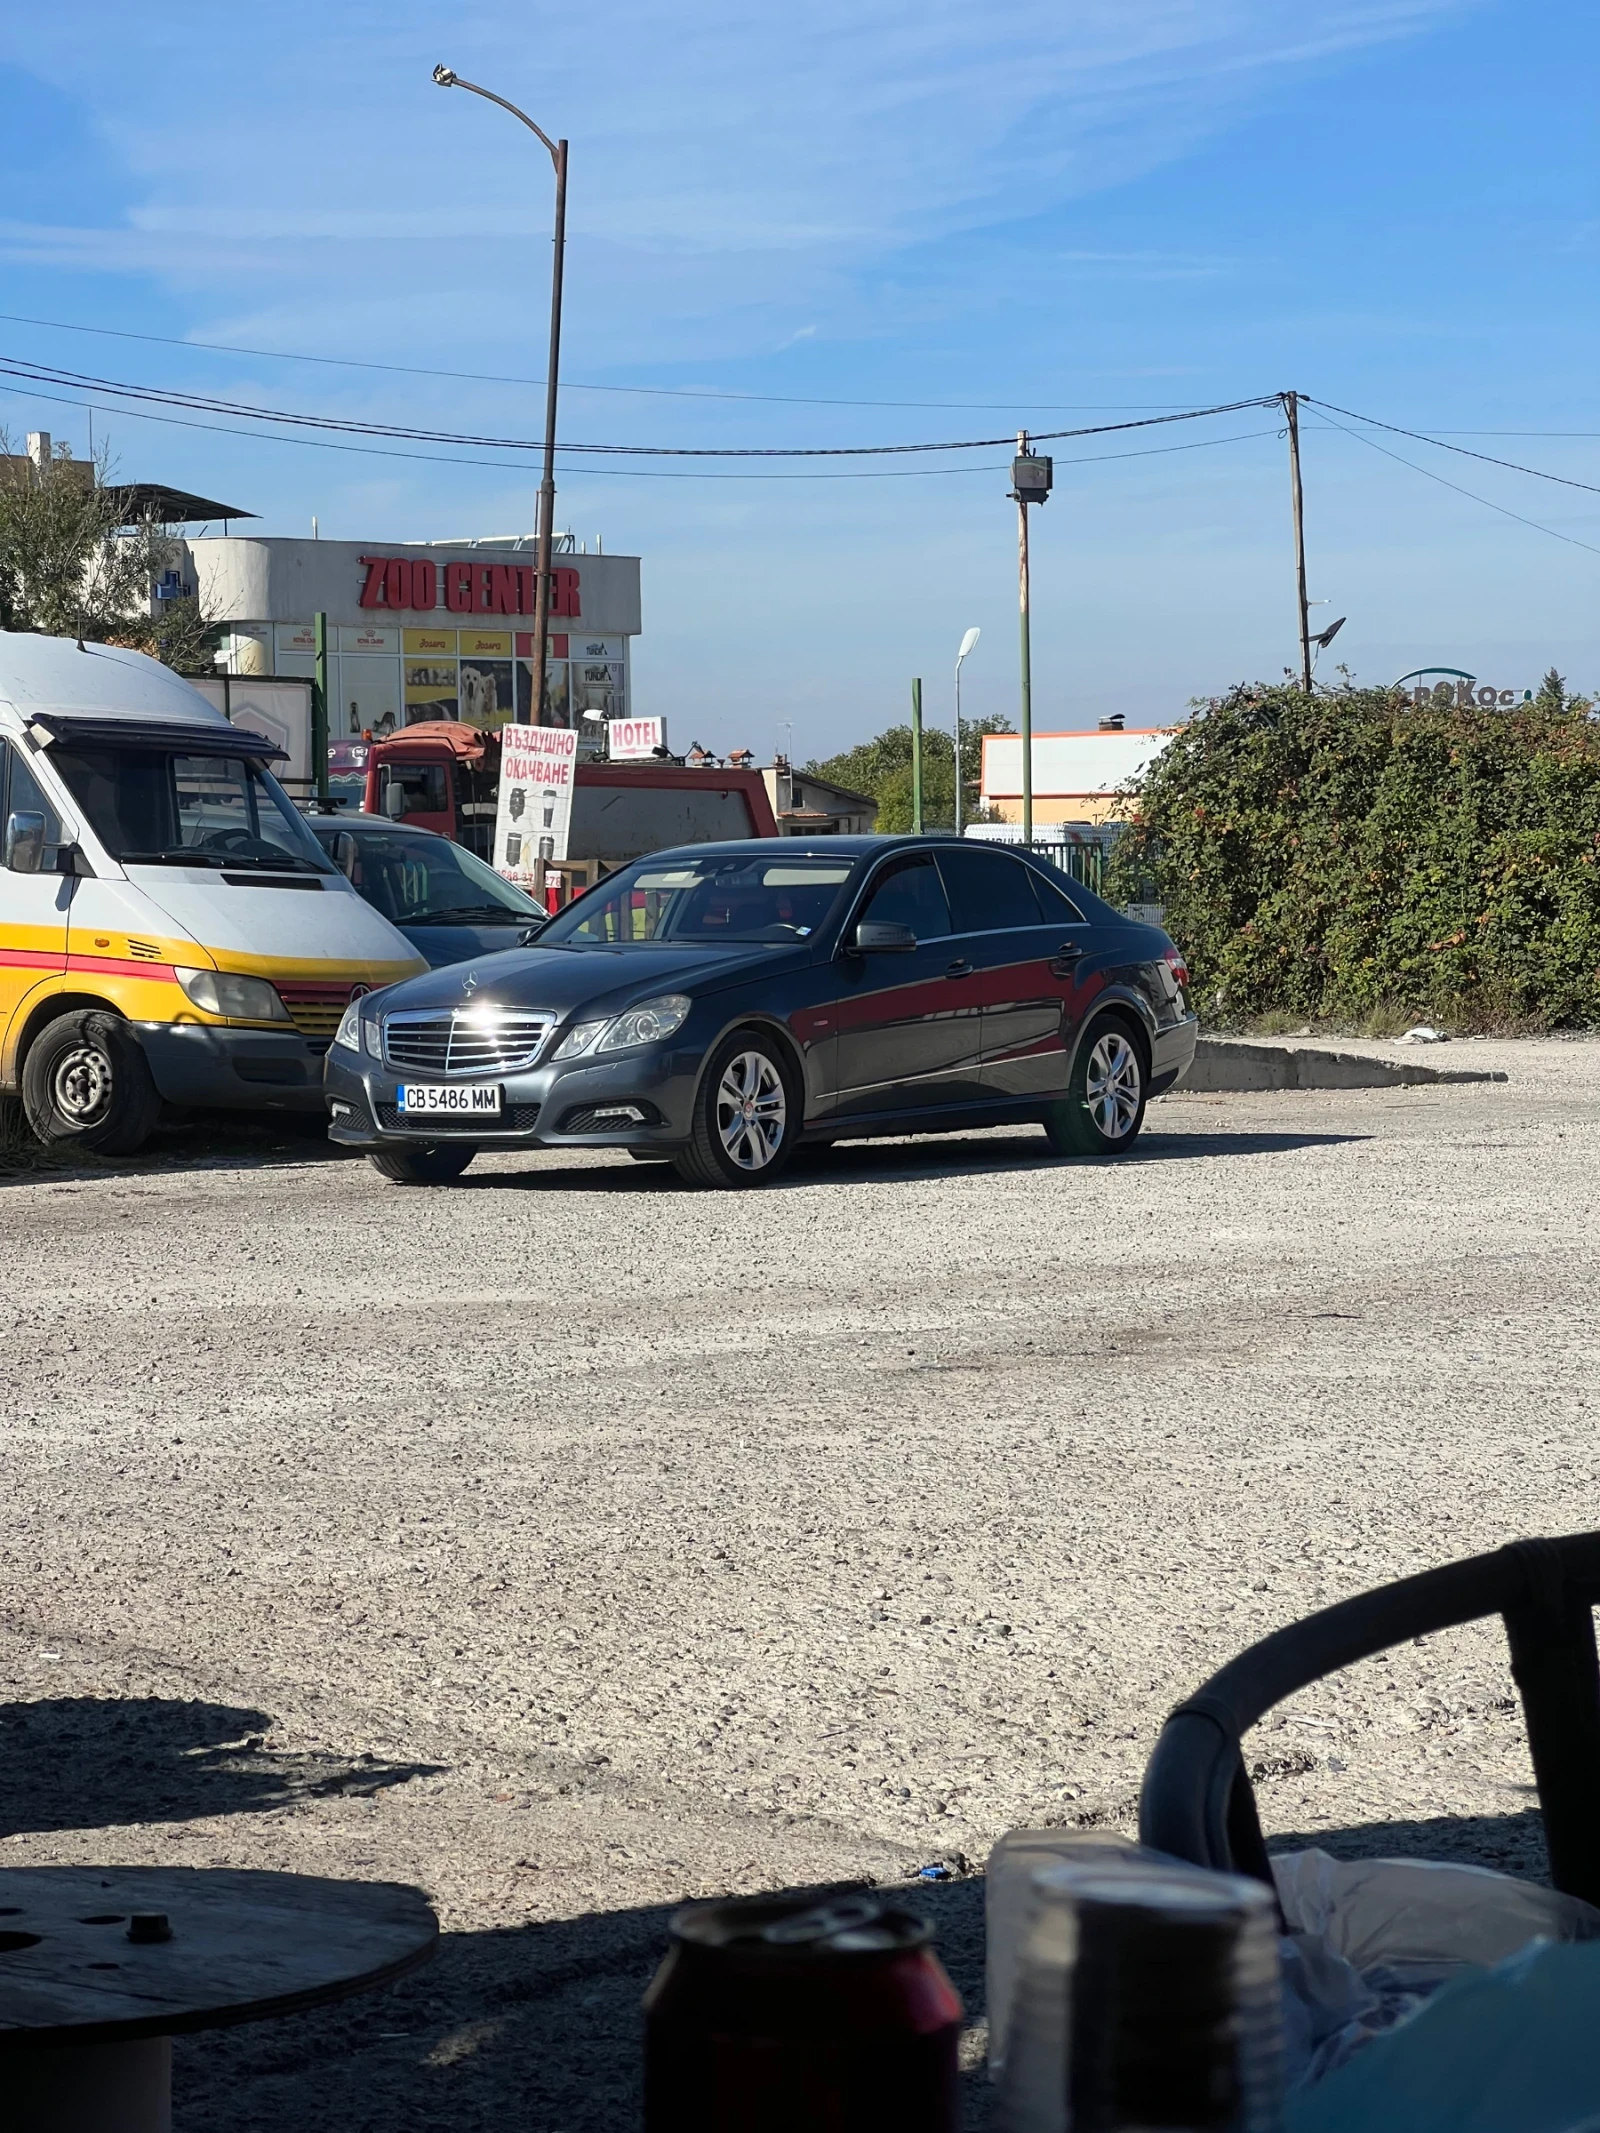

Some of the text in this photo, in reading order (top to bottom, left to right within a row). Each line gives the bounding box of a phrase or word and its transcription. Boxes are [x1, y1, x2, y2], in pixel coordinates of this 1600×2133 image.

[360, 556, 437, 611] ZOO
[505, 728, 575, 756] ВЪЗДУШНО
[613, 722, 659, 747] HOTEL
[506, 757, 569, 785] ОКАЧВАНЕ
